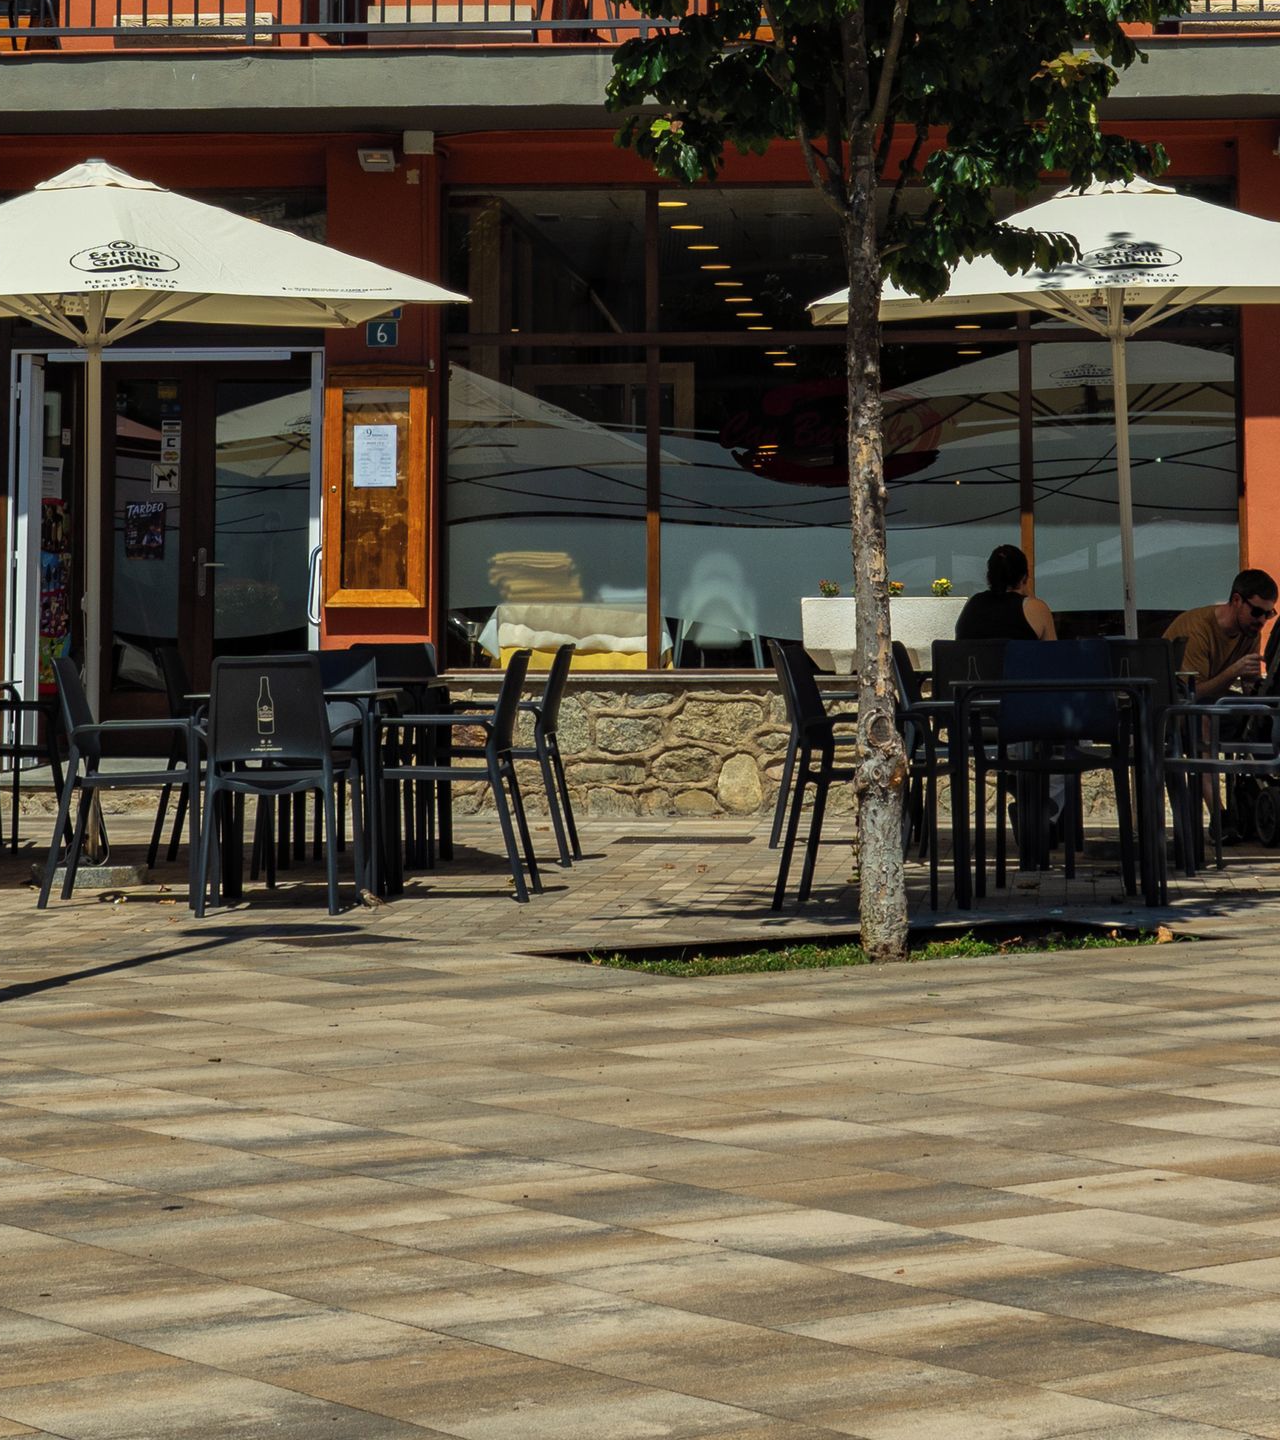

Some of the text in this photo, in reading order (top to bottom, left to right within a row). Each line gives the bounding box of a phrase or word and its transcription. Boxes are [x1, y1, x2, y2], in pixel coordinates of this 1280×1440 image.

[88, 250, 160, 262] Estrella
[1095, 250, 1163, 260] Estrella
[1098, 256, 1162, 265] Galicia
[93, 256, 159, 268] Galicia
[377, 323, 388, 343] 6
